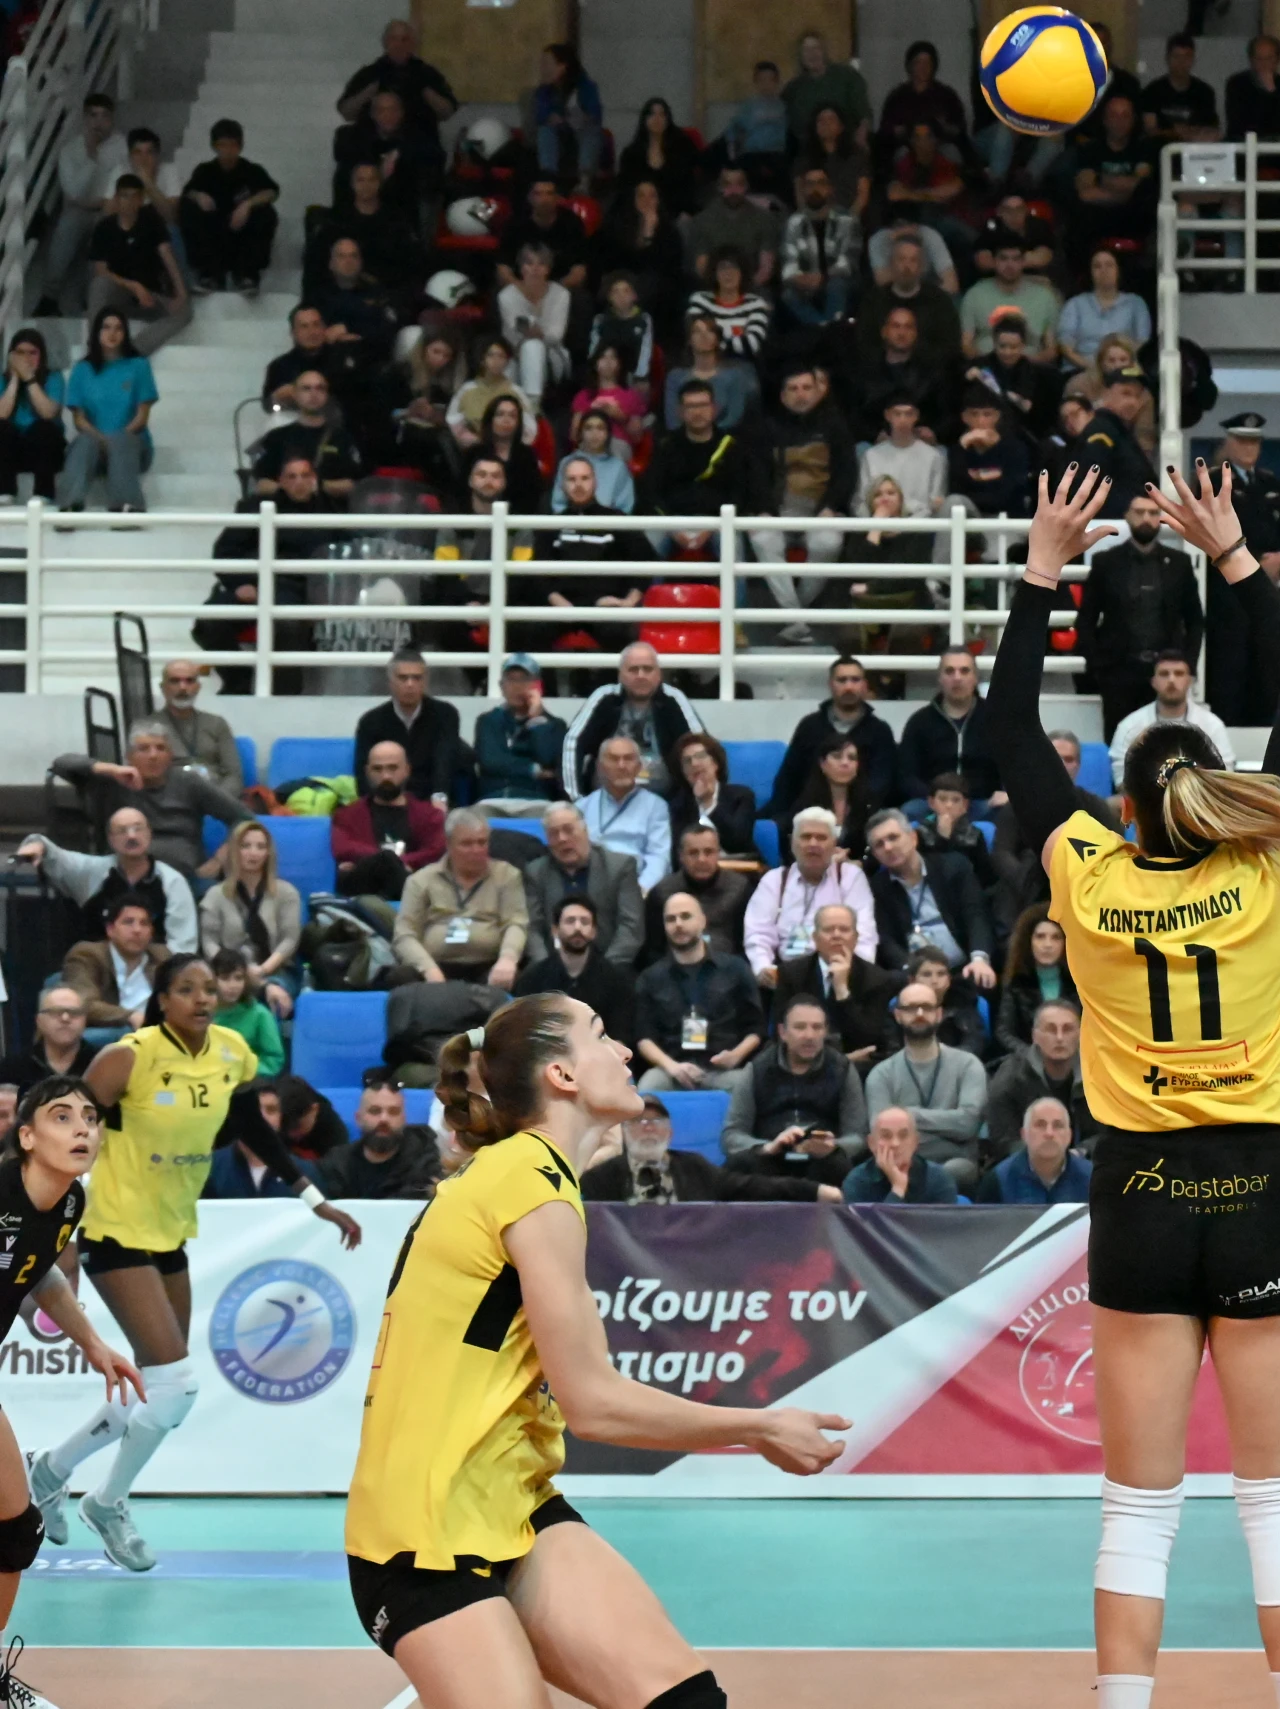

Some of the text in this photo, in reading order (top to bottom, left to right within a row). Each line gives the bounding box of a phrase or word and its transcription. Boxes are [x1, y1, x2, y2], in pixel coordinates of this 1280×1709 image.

[1098, 887, 1243, 934] ΚΩΝΣΤΑΝΤΙΝΙΔΟΥ
[1134, 937, 1222, 1042] 11
[187, 1083, 209, 1108] 12
[1171, 1174, 1270, 1198] pastabar
[14, 1254, 37, 1284] 2
[788, 1290, 867, 1321] τον
[225, 1359, 338, 1398] FEDERATION
